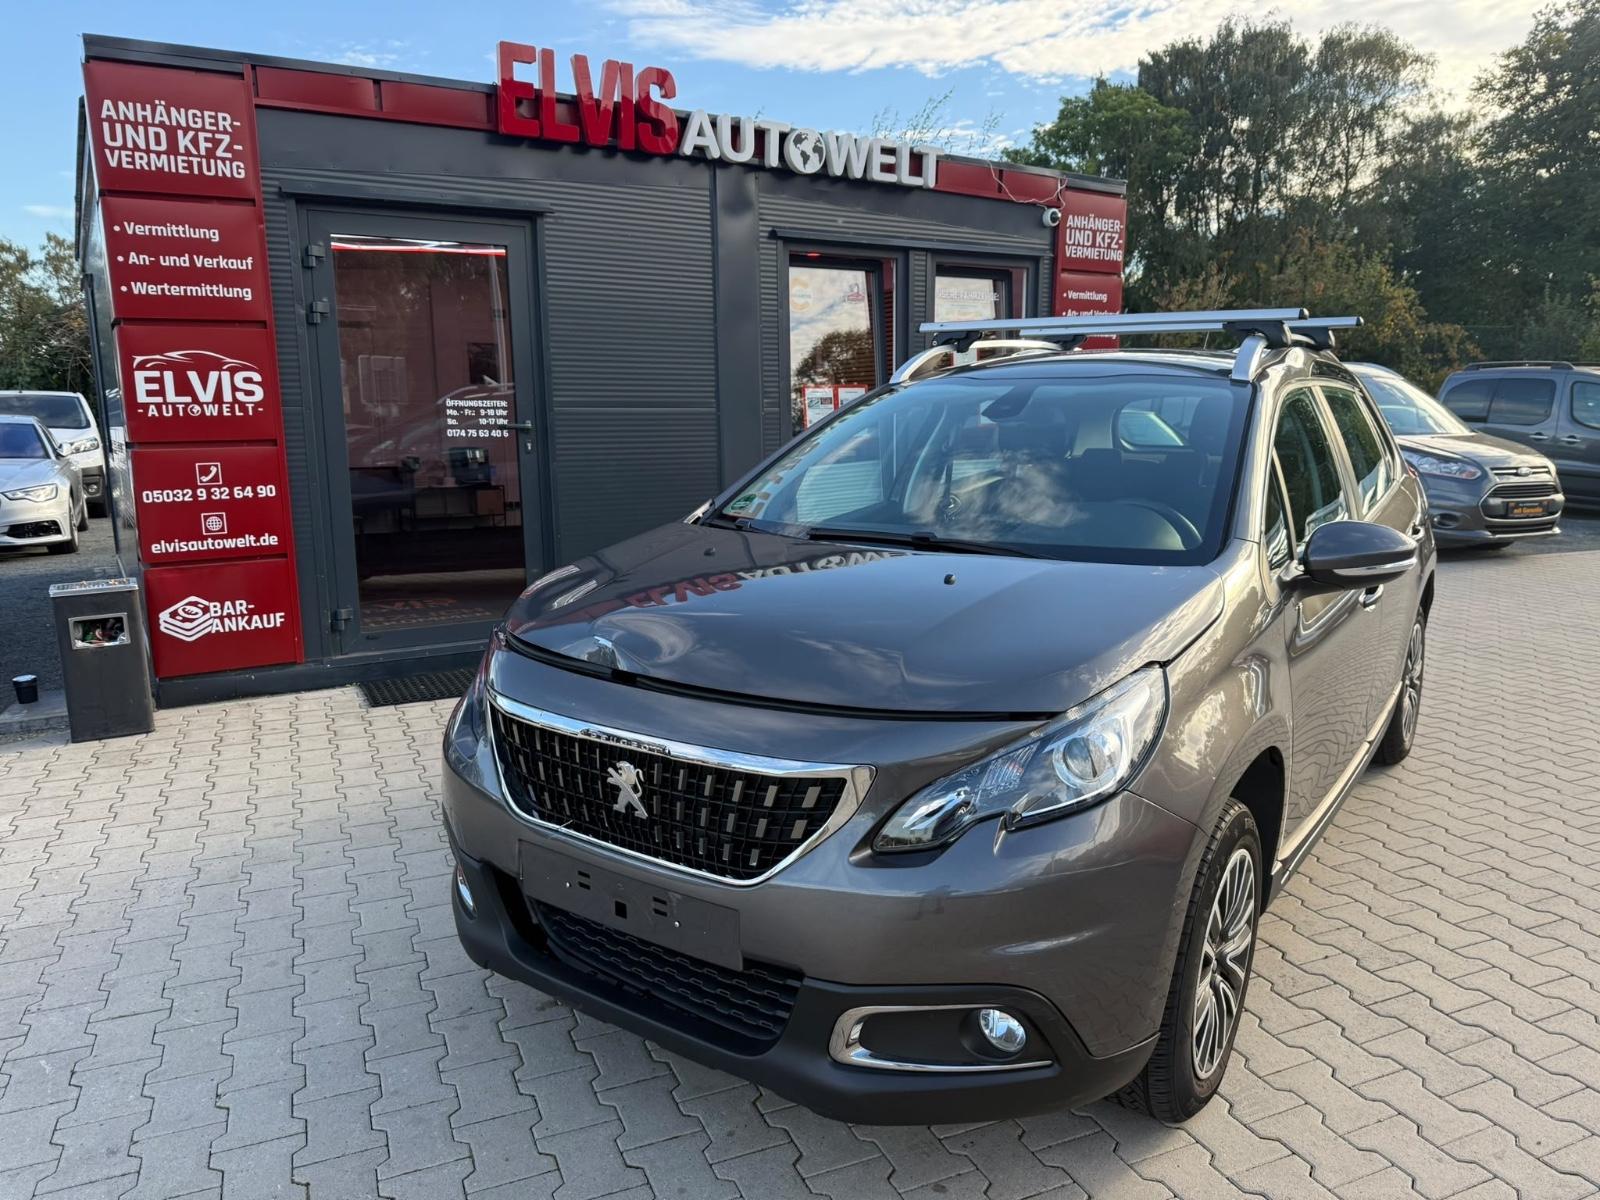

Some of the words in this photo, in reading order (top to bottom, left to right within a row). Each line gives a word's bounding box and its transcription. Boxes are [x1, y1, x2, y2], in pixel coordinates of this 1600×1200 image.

[100, 99, 241, 132] ANHÄNGER-
[496, 40, 679, 156] ELVIS
[679, 109, 946, 190] AUTOWELT
[102, 121, 167, 151] UND
[177, 130, 244, 158] KFZ-
[104, 148, 246, 179] VERMIETUNG
[124, 221, 220, 242] Vermittlung
[1066, 214, 1124, 233] ANHÄNGER-
[1066, 228, 1093, 246] UND
[1095, 232, 1123, 249] KFZ-
[128, 251, 155, 266] An-
[159, 253, 190, 267] und
[193, 254, 253, 270] Verkauf
[1065, 244, 1123, 261] VERMIETUNG
[131, 281, 252, 301] Wertermittlung
[1067, 290, 1108, 302] Vermittlung
[134, 370, 264, 403] ELVIS
[445, 398, 508, 407] ÖFFNUNGSZEITEN:
[447, 429, 466, 437] 0174
[467, 429, 477, 437] 75
[478, 429, 489, 437] 63
[490, 429, 501, 437] 40
[142, 490, 193, 504] 05032
[197, 489, 207, 501] 9
[211, 487, 230, 500] 32
[233, 486, 254, 498] 64
[256, 484, 276, 497] 90
[151, 533, 279, 554] elvisautowelt.de
[209, 600, 255, 617] BAR-
[211, 612, 285, 634] ANKAUF
